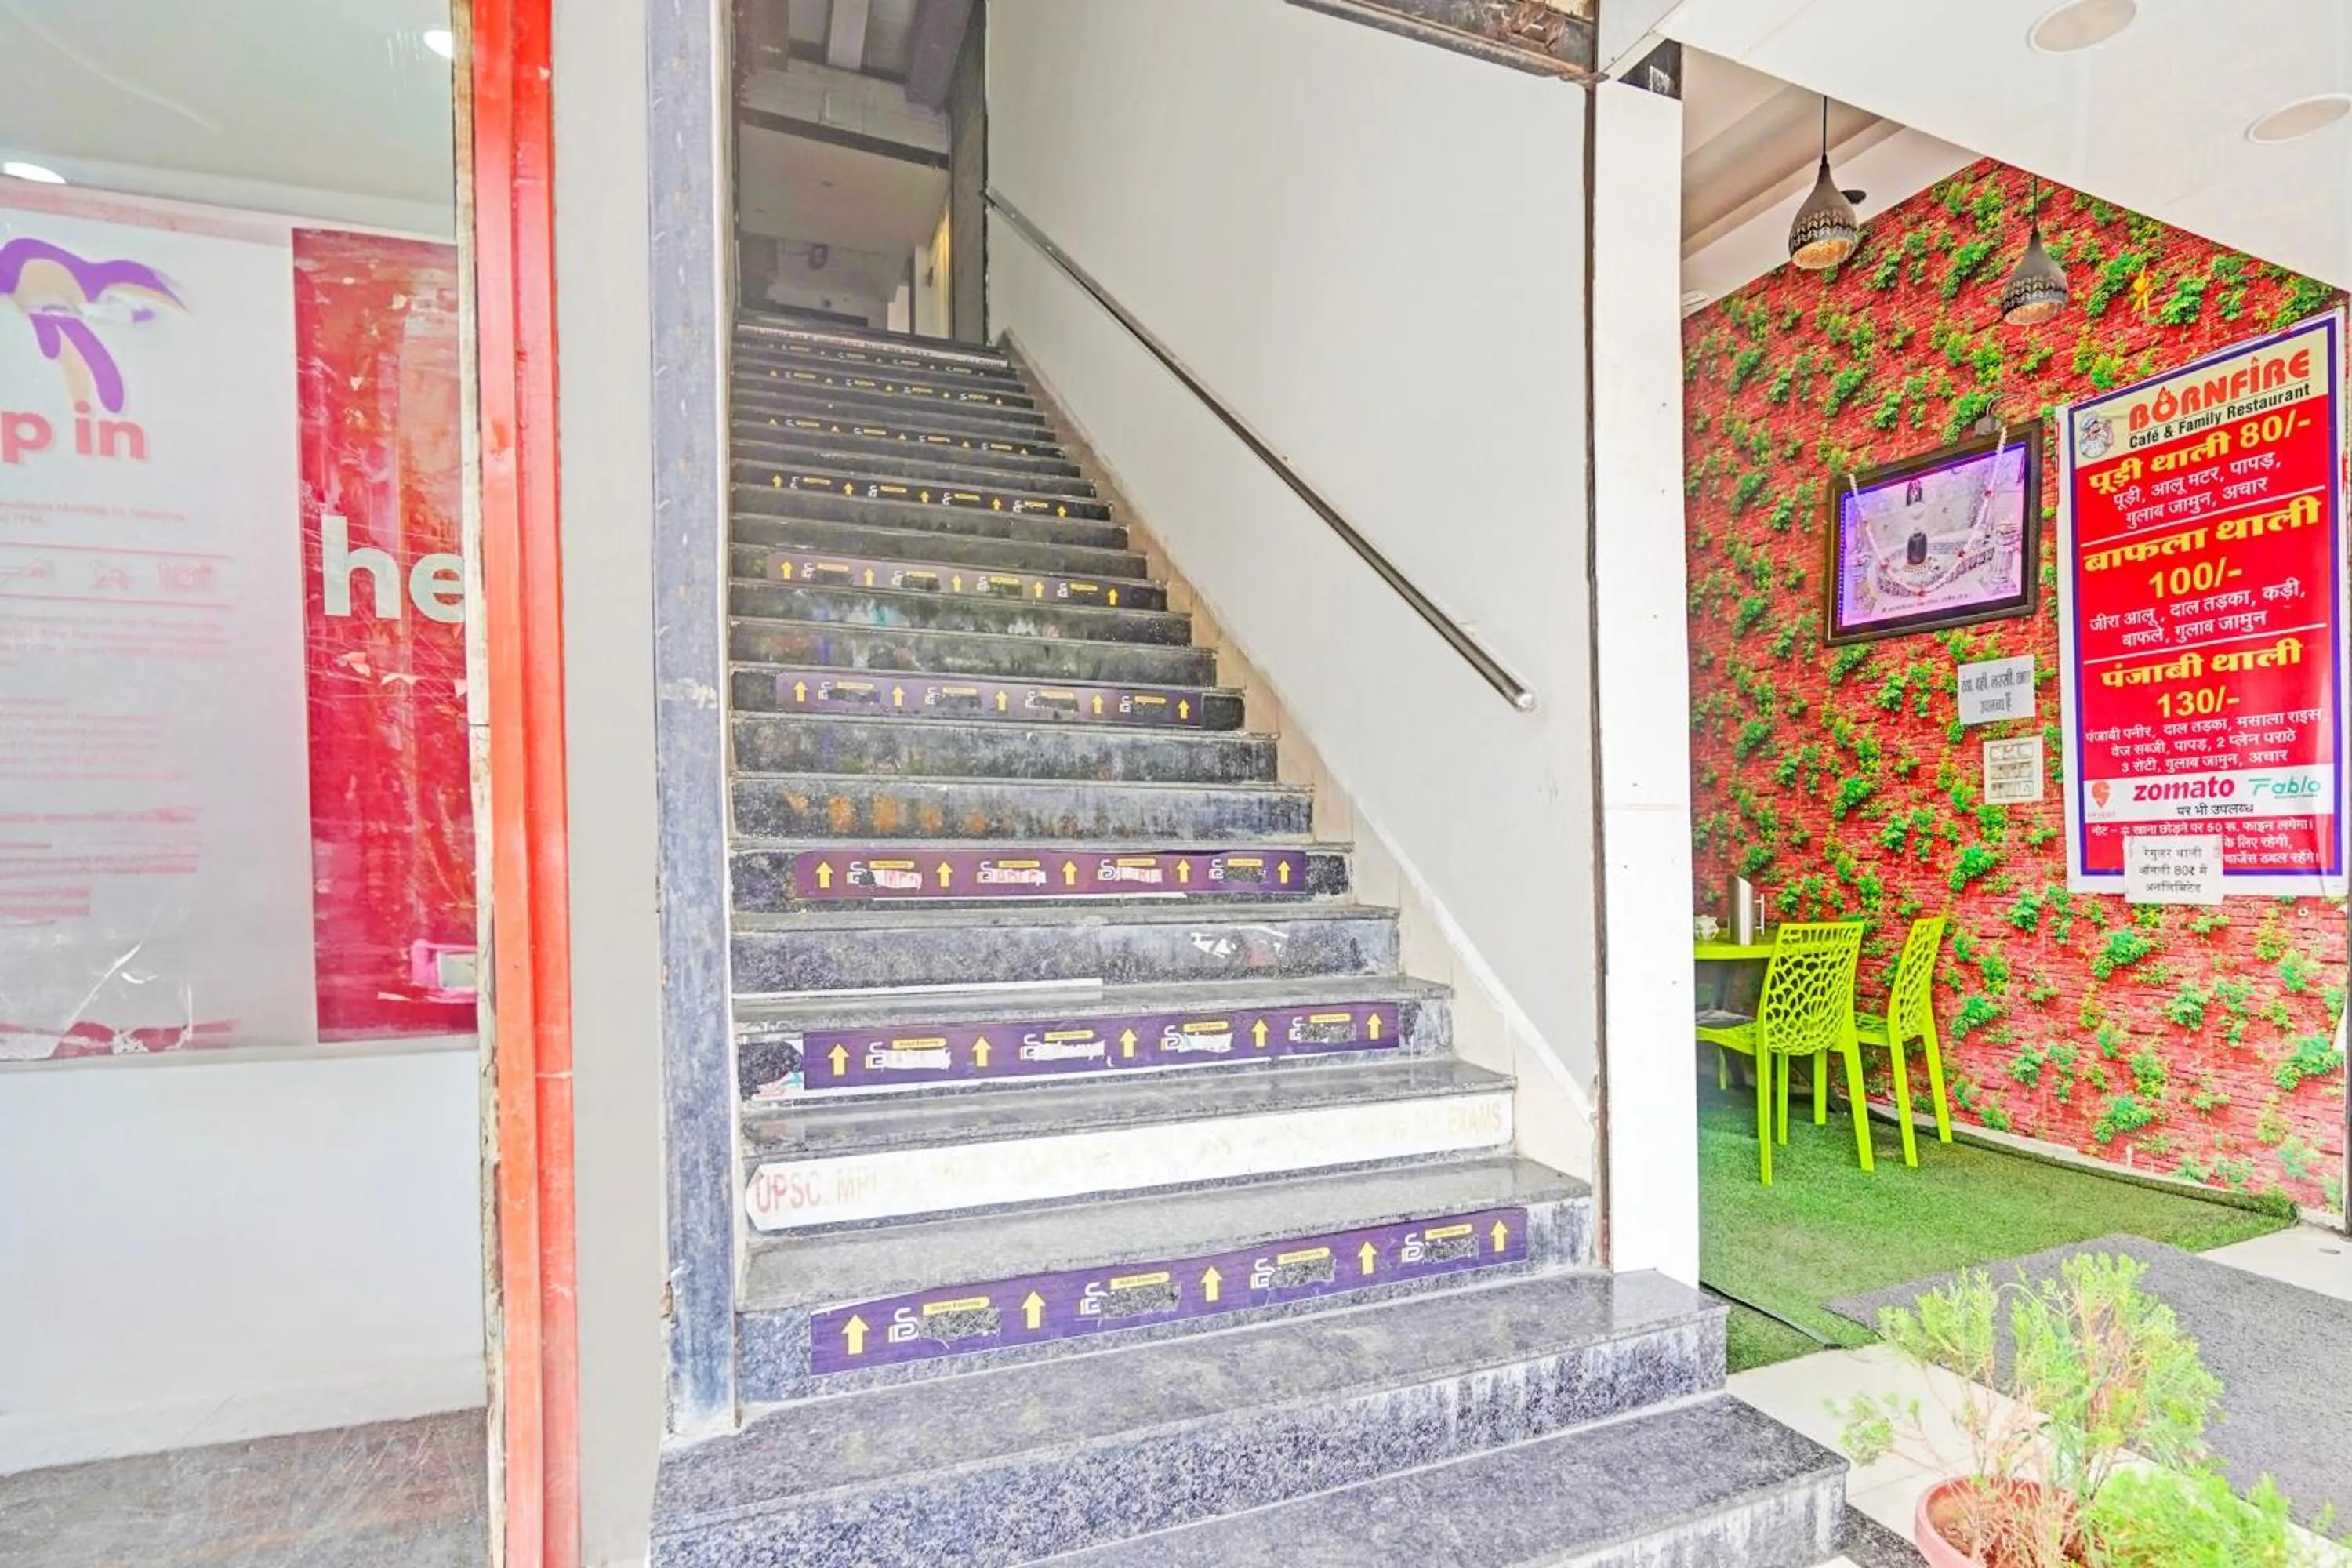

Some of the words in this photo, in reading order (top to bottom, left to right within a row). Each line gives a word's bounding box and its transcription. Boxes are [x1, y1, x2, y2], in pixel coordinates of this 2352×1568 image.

[2163, 426, 2175, 441] &
[2178, 412, 2224, 436] Family
[2227, 383, 2311, 423] Restaurant
[74, 401, 149, 461] in
[2089, 459, 2143, 495] पूड़ी
[2150, 433, 2231, 470] थाली
[2240, 411, 2311, 448] 80/-
[2151, 478, 2186, 496] आलू
[2188, 467, 2225, 487] मटर,
[2125, 503, 2165, 528] गुलाब
[2222, 478, 2268, 499] अचार
[2084, 527, 2209, 572] बाफला
[2215, 496, 2321, 539] थाली
[2148, 559, 2242, 599] 100/-
[2089, 613, 2120, 632] जीरा
[2170, 601, 2200, 618] दाल
[2175, 619, 2214, 642] गुलाब
[2218, 611, 2267, 634] जामुन
[2101, 653, 2202, 688] पंजाबी
[2210, 638, 2303, 673] थाली
[2158, 686, 2241, 718] 130/-
[2085, 729, 2121, 743] पंजाबी
[2164, 723, 2188, 735] दाल
[2235, 714, 2285, 728] मसाला
[2111, 743, 2132, 757] वेज
[2216, 739, 2225, 749] 2
[2229, 731, 2259, 747] प्लेन
[2121, 762, 2129, 773] 3
[2248, 749, 2289, 764] अचार
[2133, 777, 2235, 802] zomato
[2177, 804, 2192, 816] पर
[2195, 802, 2209, 815] भी
[2212, 803, 2254, 815] उपलब्ध
[2190, 822, 2205, 834] पर
[2206, 822, 2222, 833] 50
